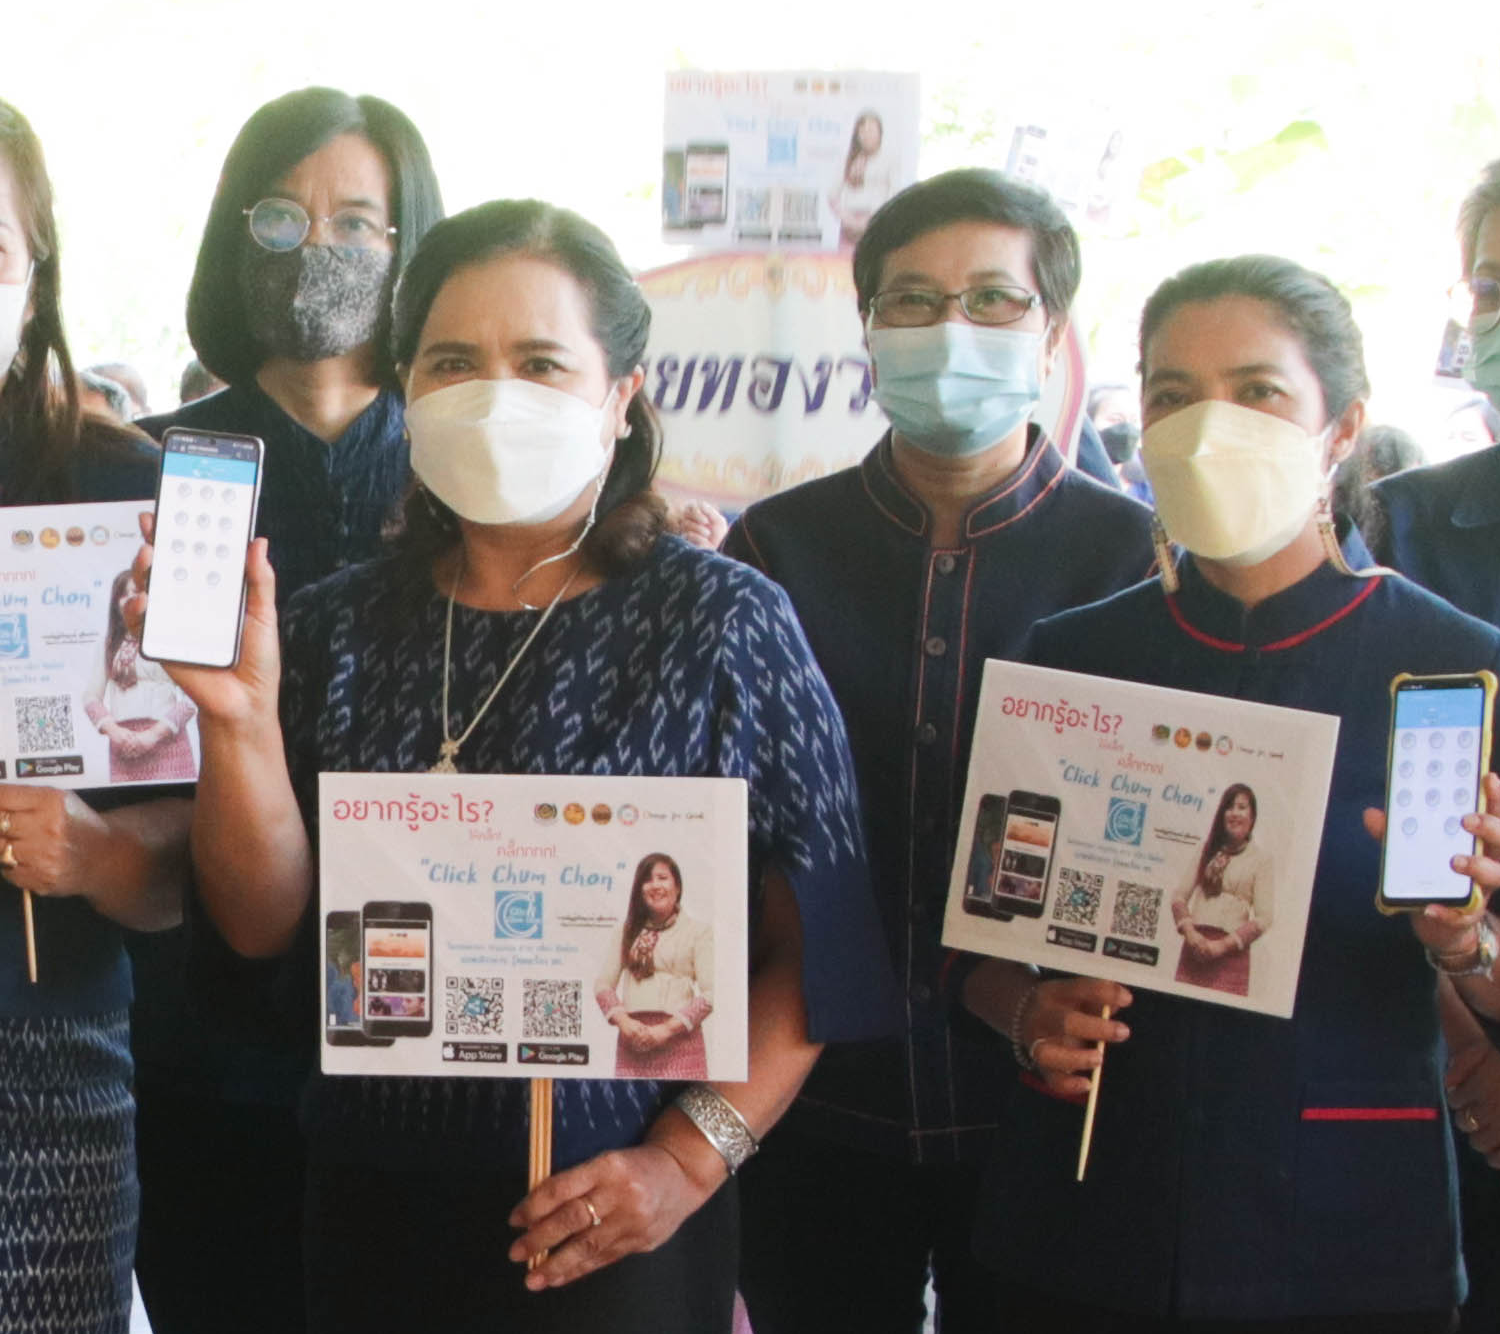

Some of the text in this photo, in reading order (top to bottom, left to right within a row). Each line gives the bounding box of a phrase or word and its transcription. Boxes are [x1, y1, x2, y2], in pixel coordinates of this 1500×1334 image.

[332, 793, 495, 832] อยากรู้อะไร?
